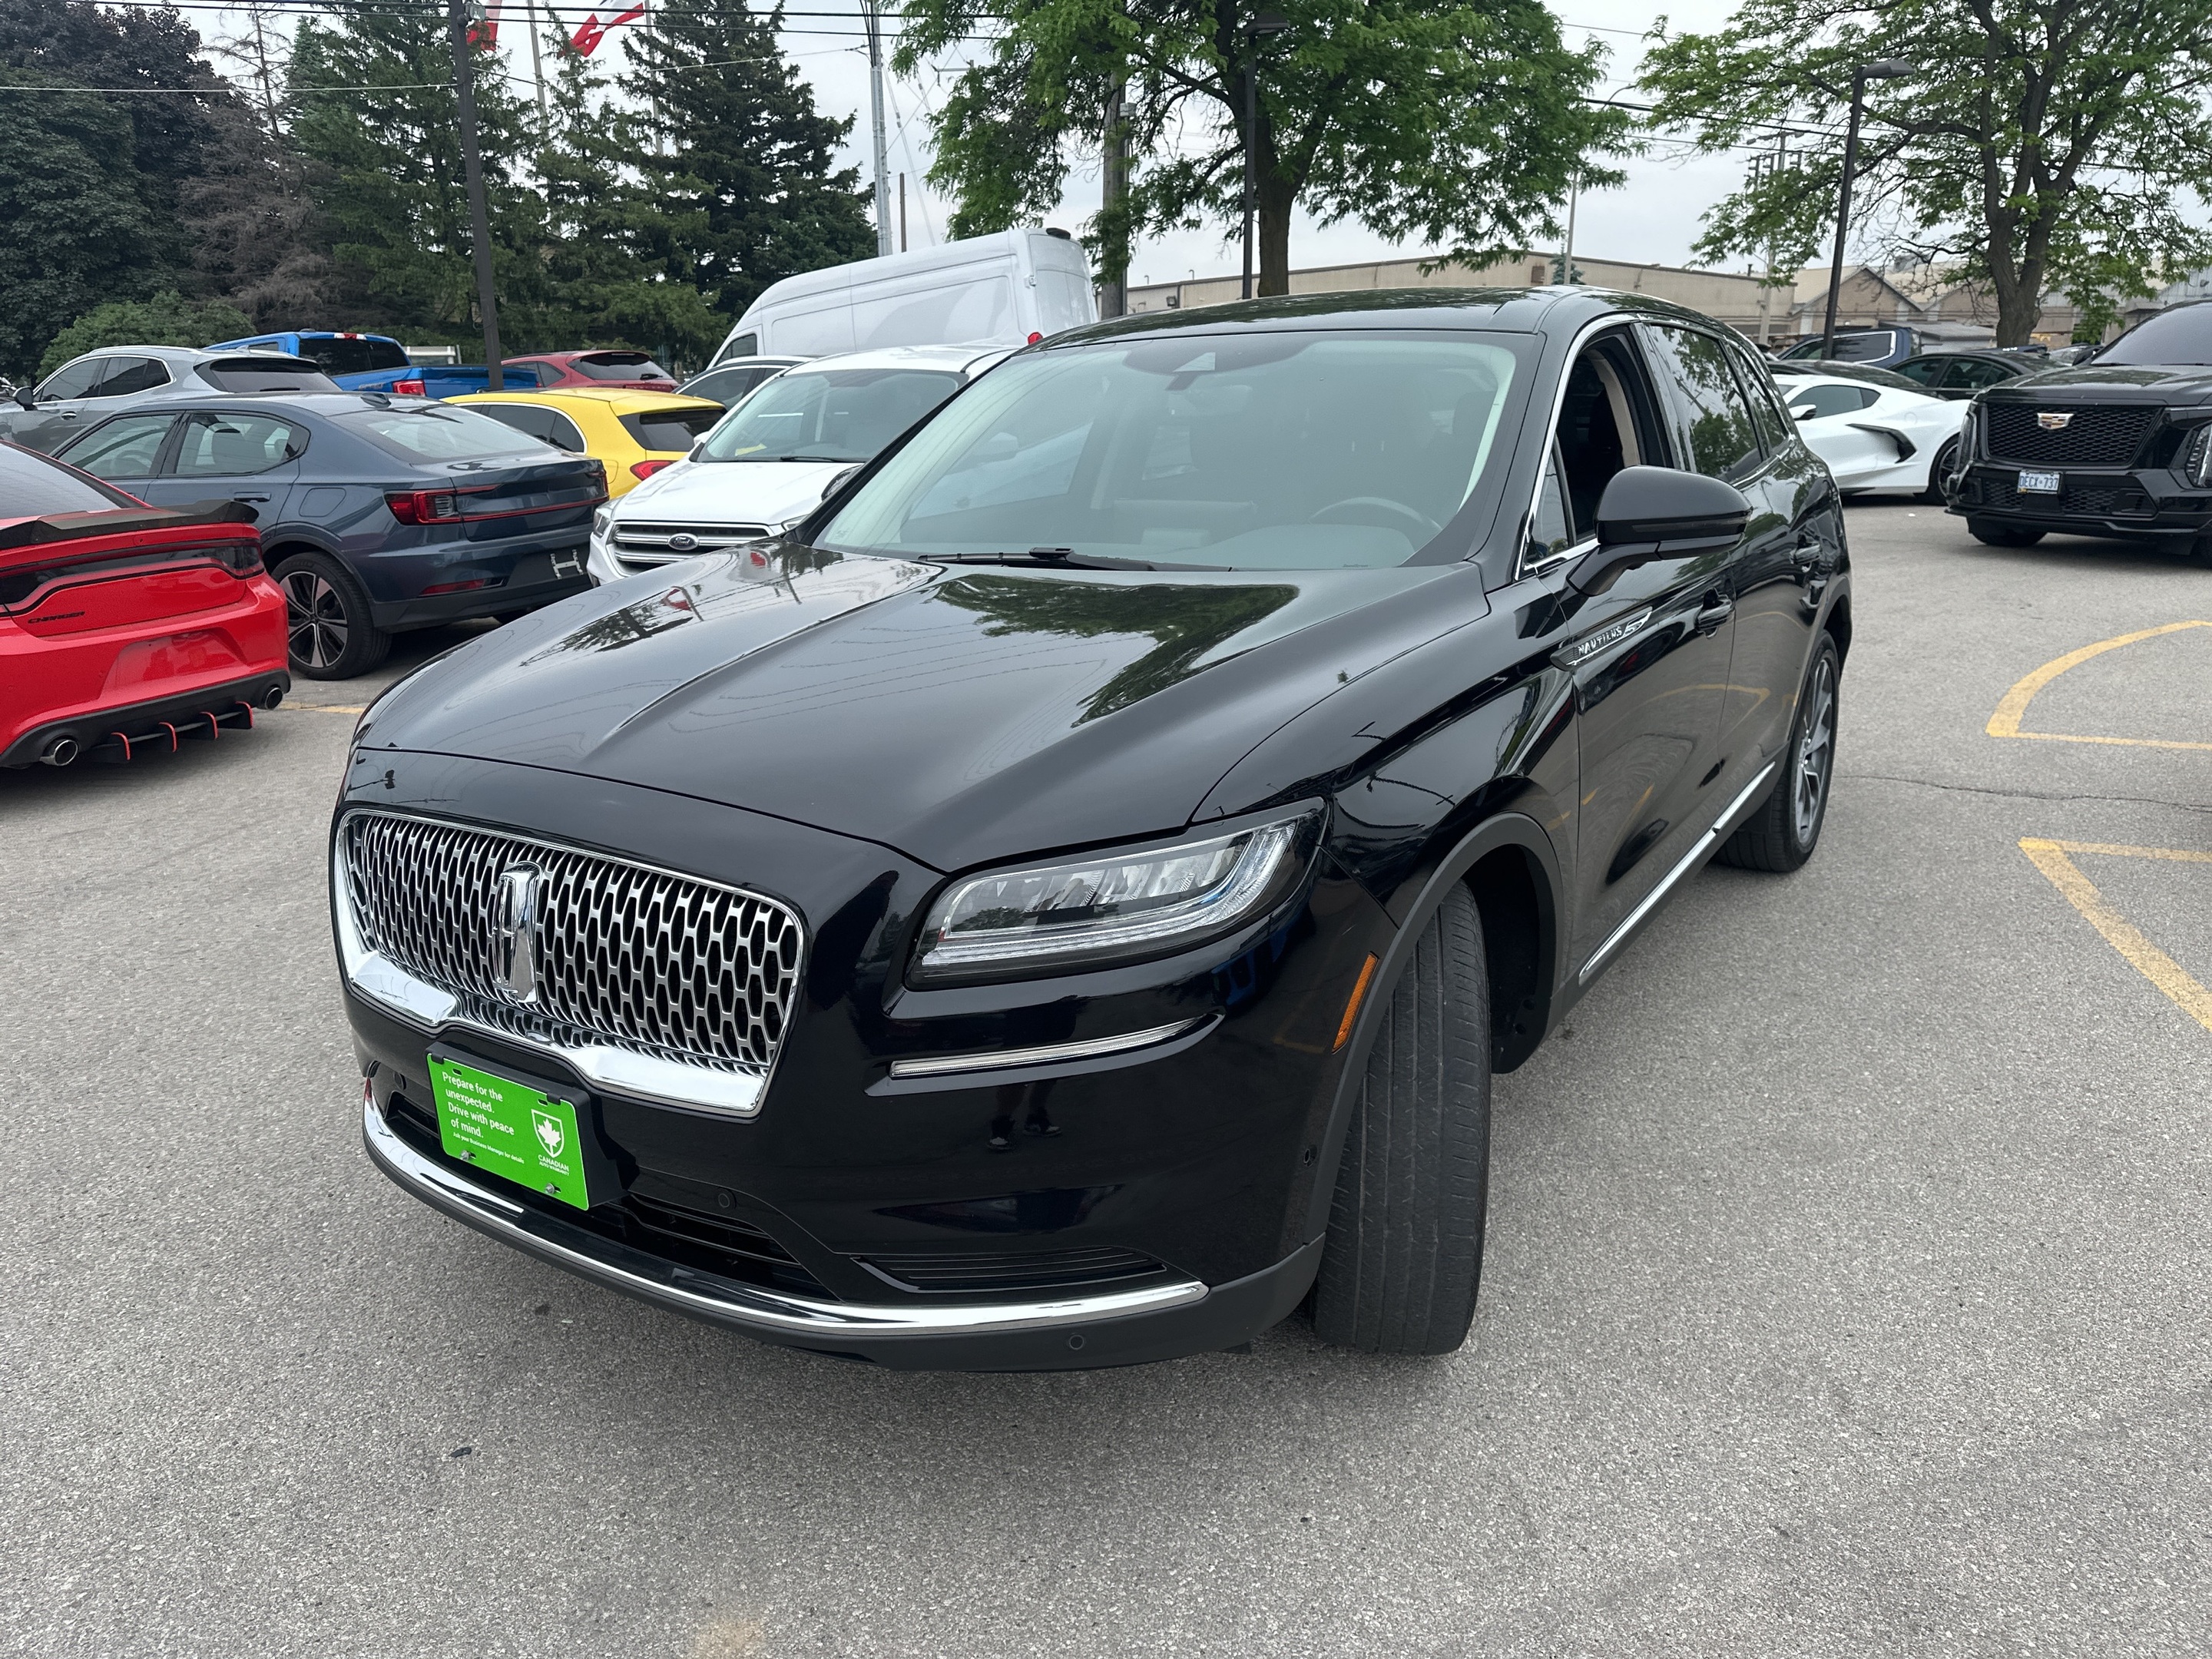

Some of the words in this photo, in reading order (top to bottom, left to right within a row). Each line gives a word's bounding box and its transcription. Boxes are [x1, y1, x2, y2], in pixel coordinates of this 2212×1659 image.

[2019, 476, 2039, 487] DECX
[2044, 477, 2058, 489] 737
[1578, 625, 1623, 656] NAUTILUS
[442, 1071, 475, 1091] Prepare
[475, 1083, 488, 1096] for
[489, 1088, 503, 1101] the
[445, 1088, 495, 1113] unexpected.
[448, 1101, 469, 1118] Drive
[470, 1111, 488, 1126] with
[490, 1119, 515, 1136] peace
[451, 1118, 460, 1129] of
[461, 1123, 484, 1138] mind.
[538, 1154, 569, 1172] CANADIAN
